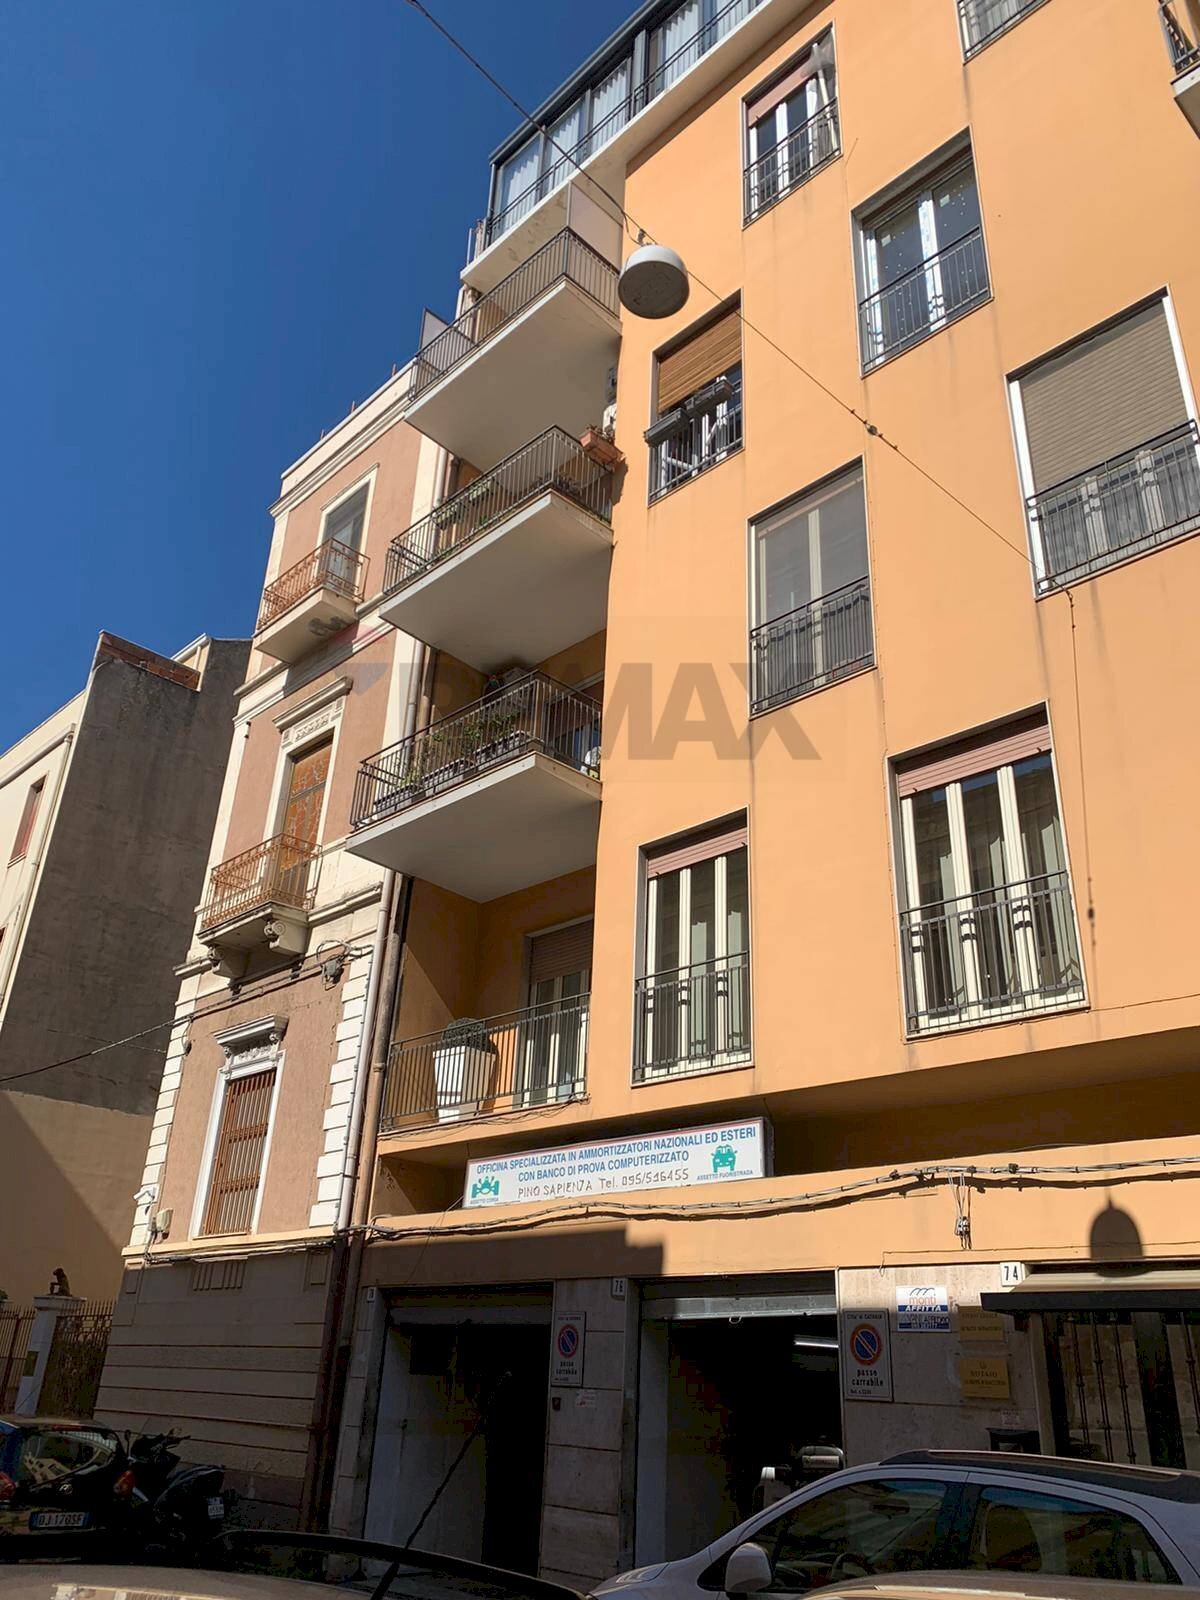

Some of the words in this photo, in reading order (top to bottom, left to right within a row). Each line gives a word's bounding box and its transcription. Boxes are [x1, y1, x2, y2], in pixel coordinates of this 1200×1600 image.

[477, 1160, 508, 1174] OFFICINA
[510, 1153, 566, 1169] SPECIALIZZATA
[568, 1151, 577, 1161] IN
[578, 1140, 652, 1159] AMMORTIZZATORI
[654, 1133, 703, 1150] NAZIONALI
[705, 1132, 718, 1144] ED
[721, 1126, 756, 1141] ESTERI
[518, 1170, 535, 1182] CON
[536, 1166, 566, 1180] BANCO
[567, 1165, 576, 1176] DI
[577, 1161, 606, 1175] PROVA
[607, 1150, 690, 1171] COMPUTERIZZATO
[518, 1186, 540, 1199] PINO
[599, 1176, 618, 1190] Tel.
[1004, 1266, 1018, 1280] 74
[852, 1378, 884, 1386] carrabile
